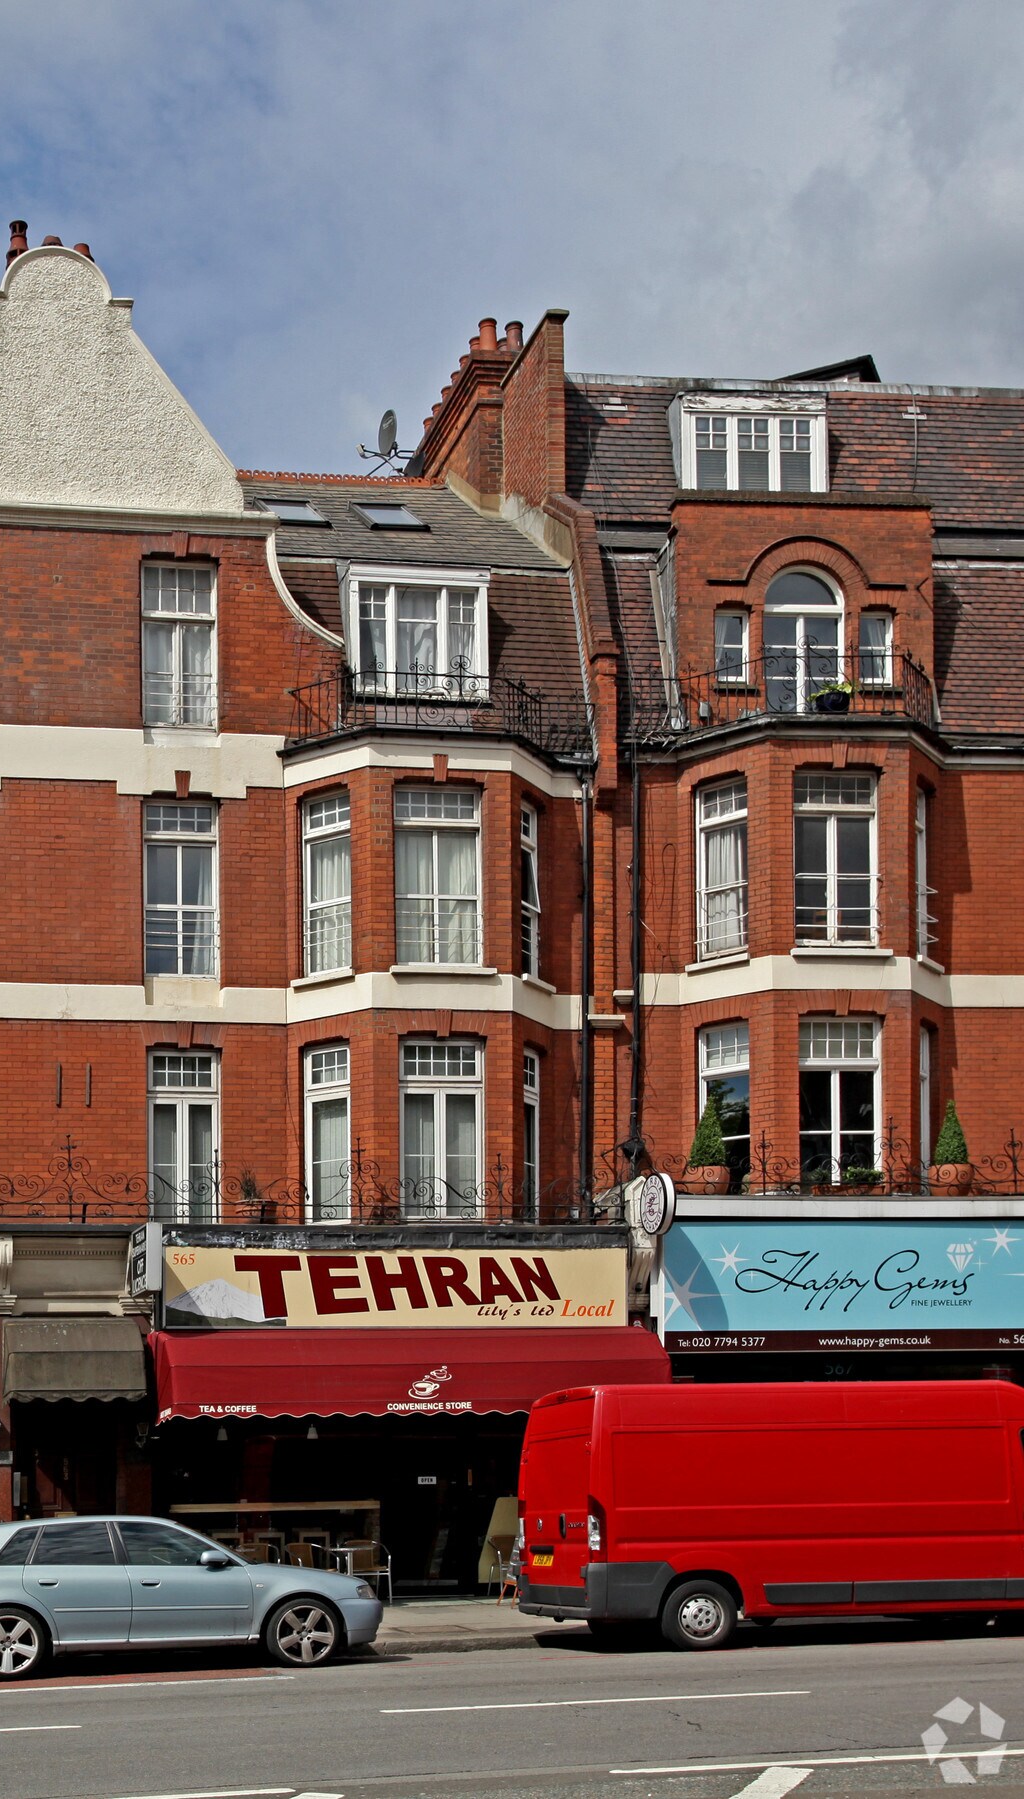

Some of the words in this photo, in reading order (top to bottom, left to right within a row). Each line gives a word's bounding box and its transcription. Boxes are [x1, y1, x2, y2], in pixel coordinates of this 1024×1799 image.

[172, 1253, 196, 1265] 565
[735, 1250, 870, 1312] Happy
[874, 1249, 975, 1309] Gems
[233, 1255, 561, 1319] TEHRAN
[560, 1299, 615, 1317] Local
[930, 1299, 973, 1307] JEWELLERY
[678, 1339, 691, 1347] Tel:
[692, 1337, 711, 1347] 020
[714, 1337, 738, 1346] 7794
[741, 1337, 766, 1346] 5377
[818, 1335, 931, 1347] www.happy-gems.co.uk
